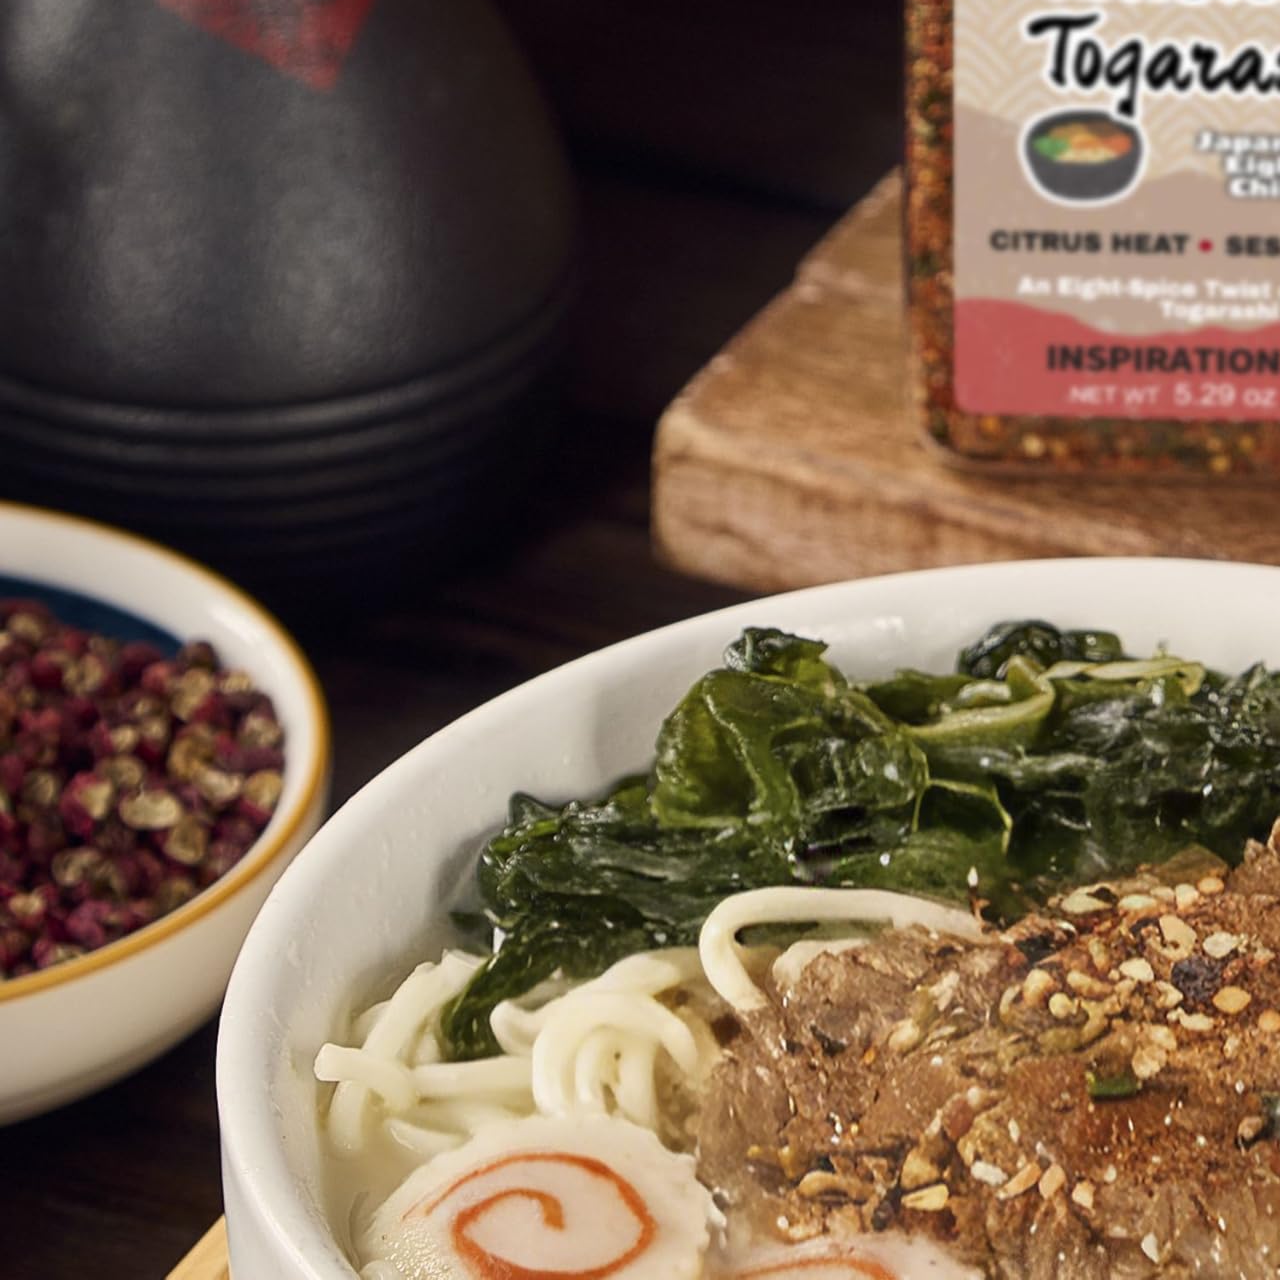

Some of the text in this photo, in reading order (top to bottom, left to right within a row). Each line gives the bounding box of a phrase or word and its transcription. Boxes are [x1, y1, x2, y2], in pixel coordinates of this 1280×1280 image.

[989, 231, 1101, 254] CITRUS
[1110, 234, 1189, 255] HEAT
[1017, 277, 1051, 295] An
[1057, 278, 1196, 300] Eight-Spice
[1204, 282, 1270, 299] Twist
[1160, 300, 1280, 323] Togarashi
[1046, 345, 1280, 374] INSPIRATION
[1067, 385, 1115, 405] NET
[1174, 382, 1236, 407] 5.29
[1243, 389, 1276, 408] oz
